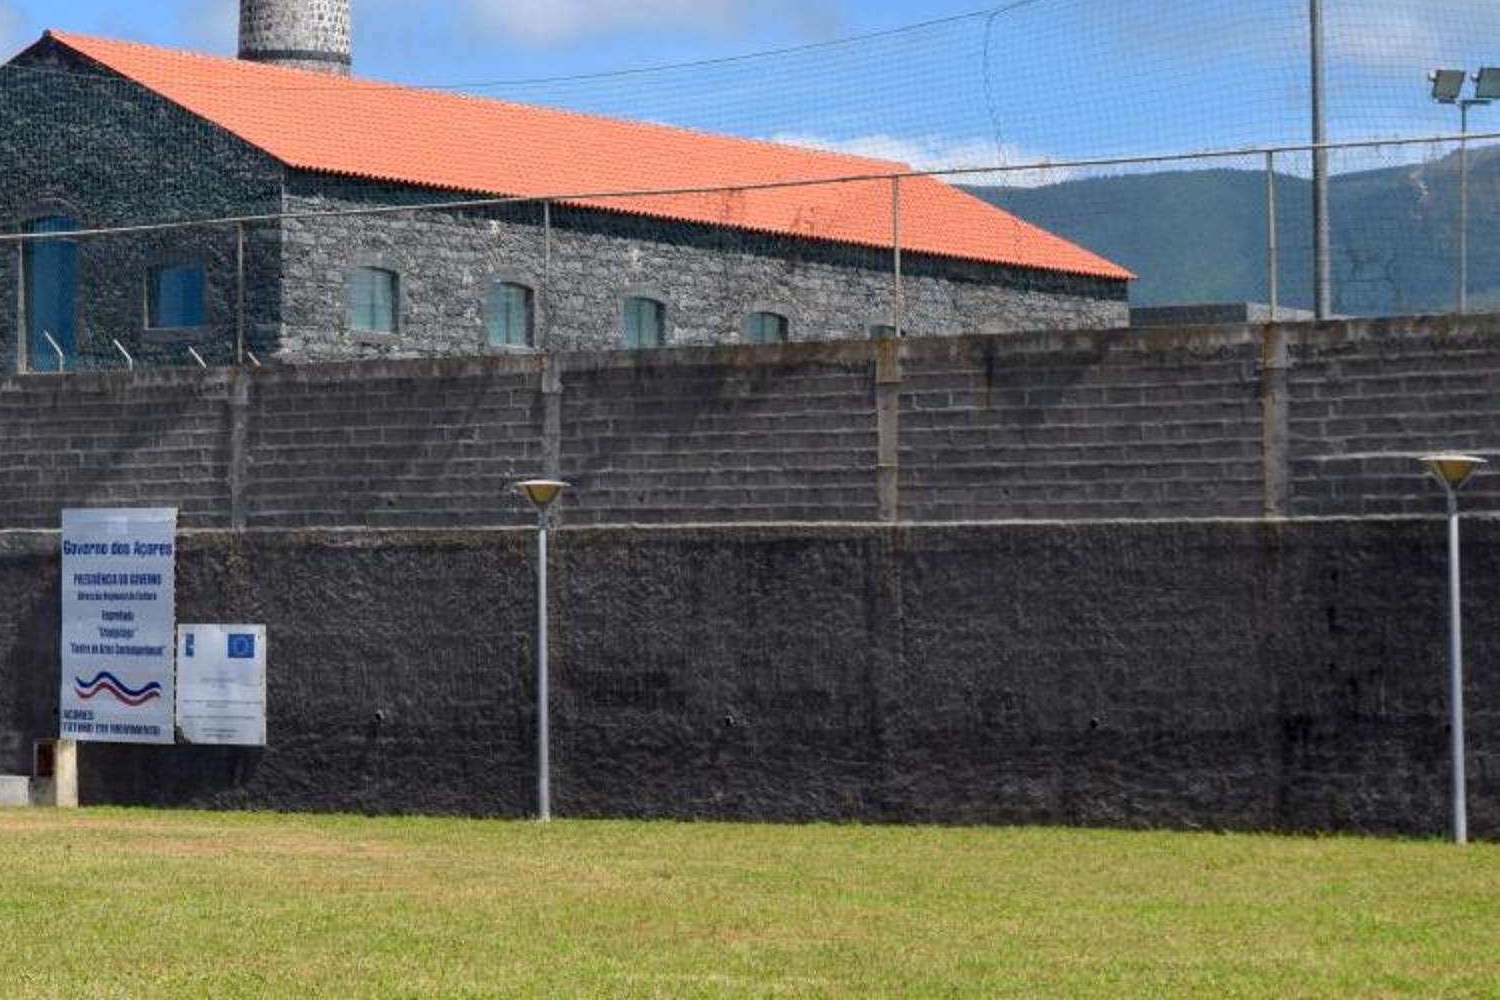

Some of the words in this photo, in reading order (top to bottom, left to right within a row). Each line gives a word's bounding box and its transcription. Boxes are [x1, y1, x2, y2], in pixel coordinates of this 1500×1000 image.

[63, 540, 108, 555] Governo
[111, 541, 130, 555] dos
[133, 540, 173, 558] Açores
